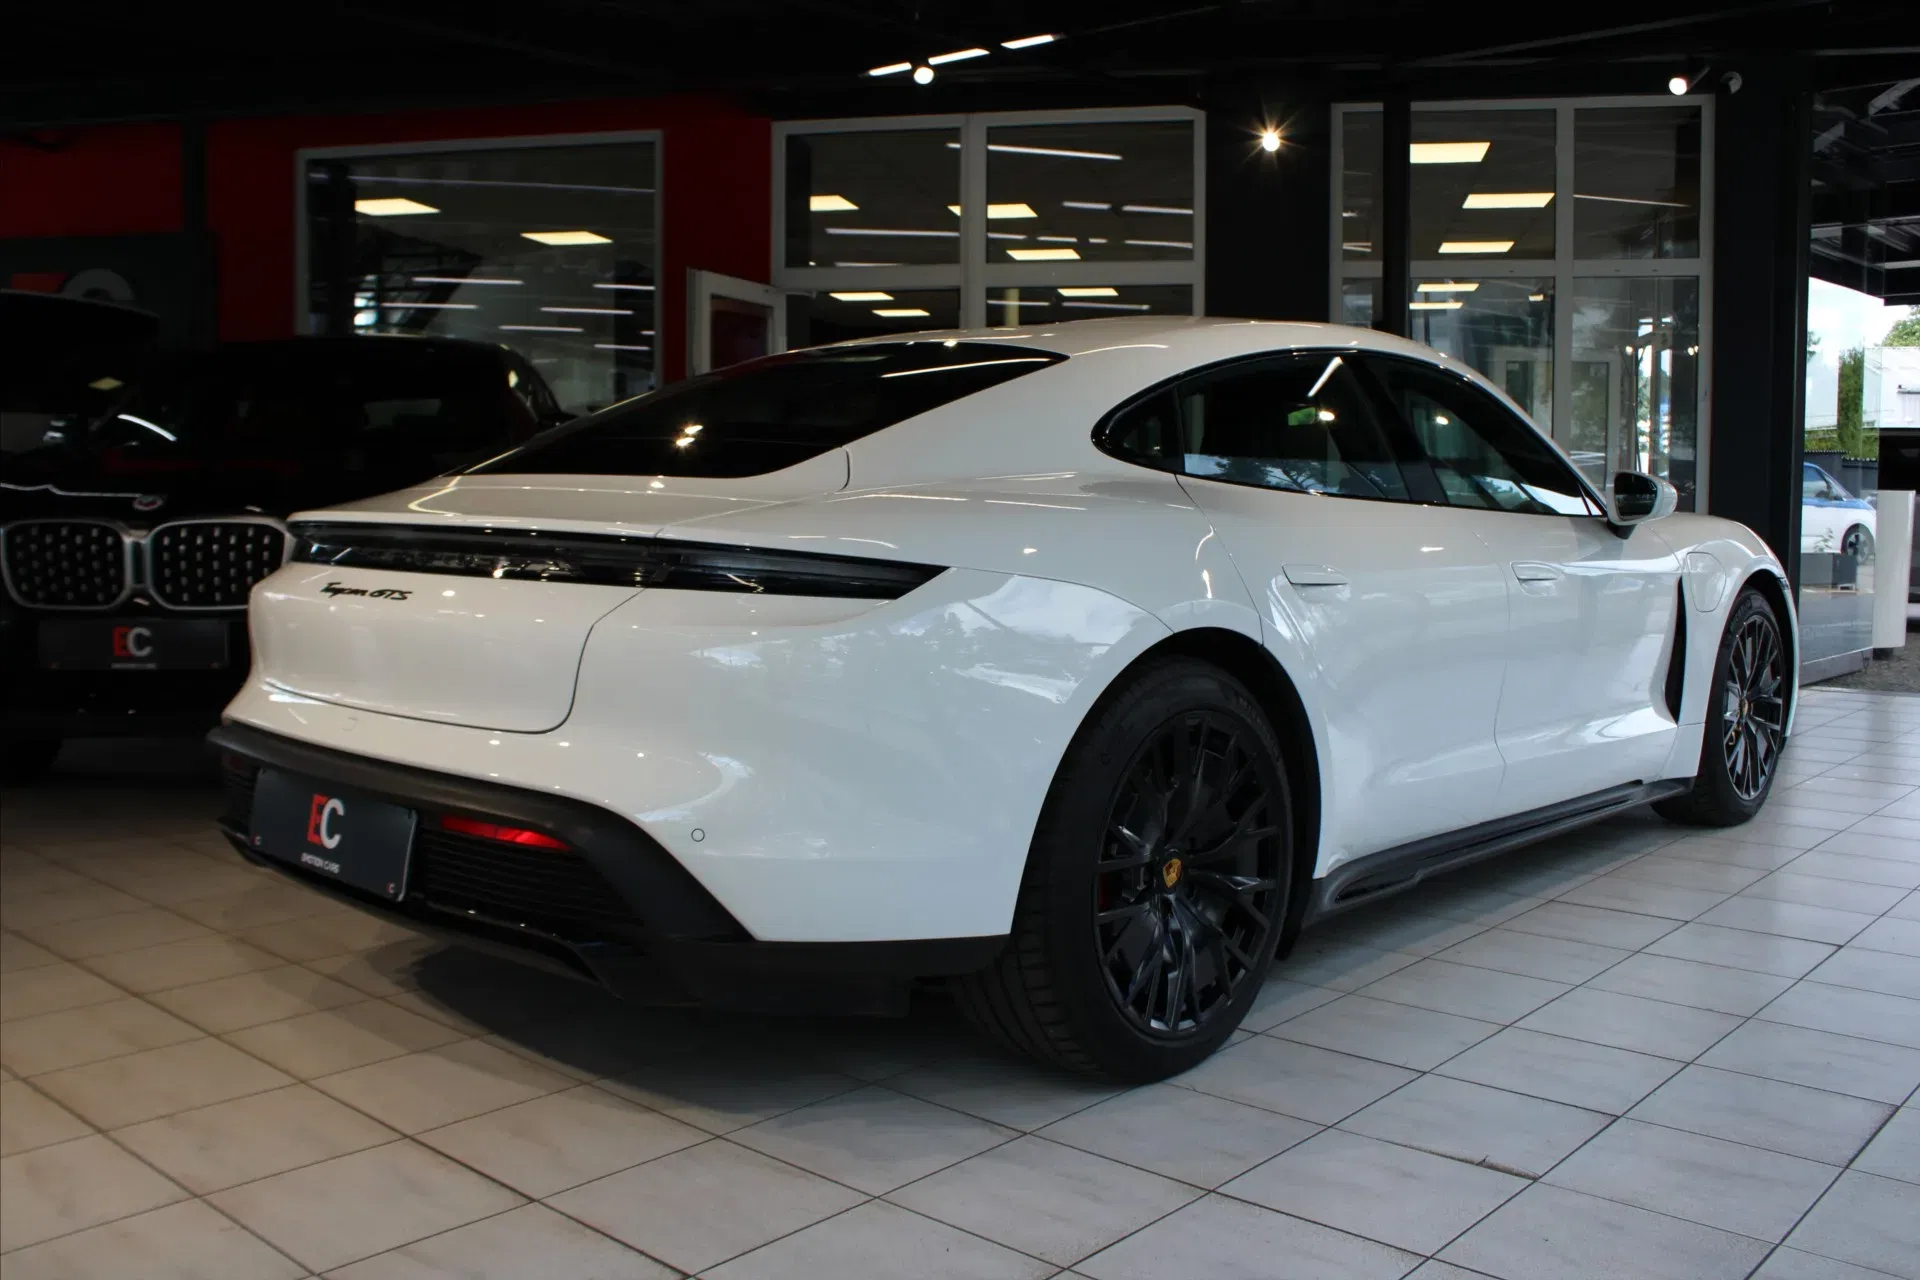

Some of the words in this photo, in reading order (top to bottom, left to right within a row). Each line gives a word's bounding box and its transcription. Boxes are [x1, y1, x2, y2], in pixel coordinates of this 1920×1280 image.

[370, 588, 412, 601] GTS
[112, 625, 153, 658] EC
[306, 793, 345, 849] EC
